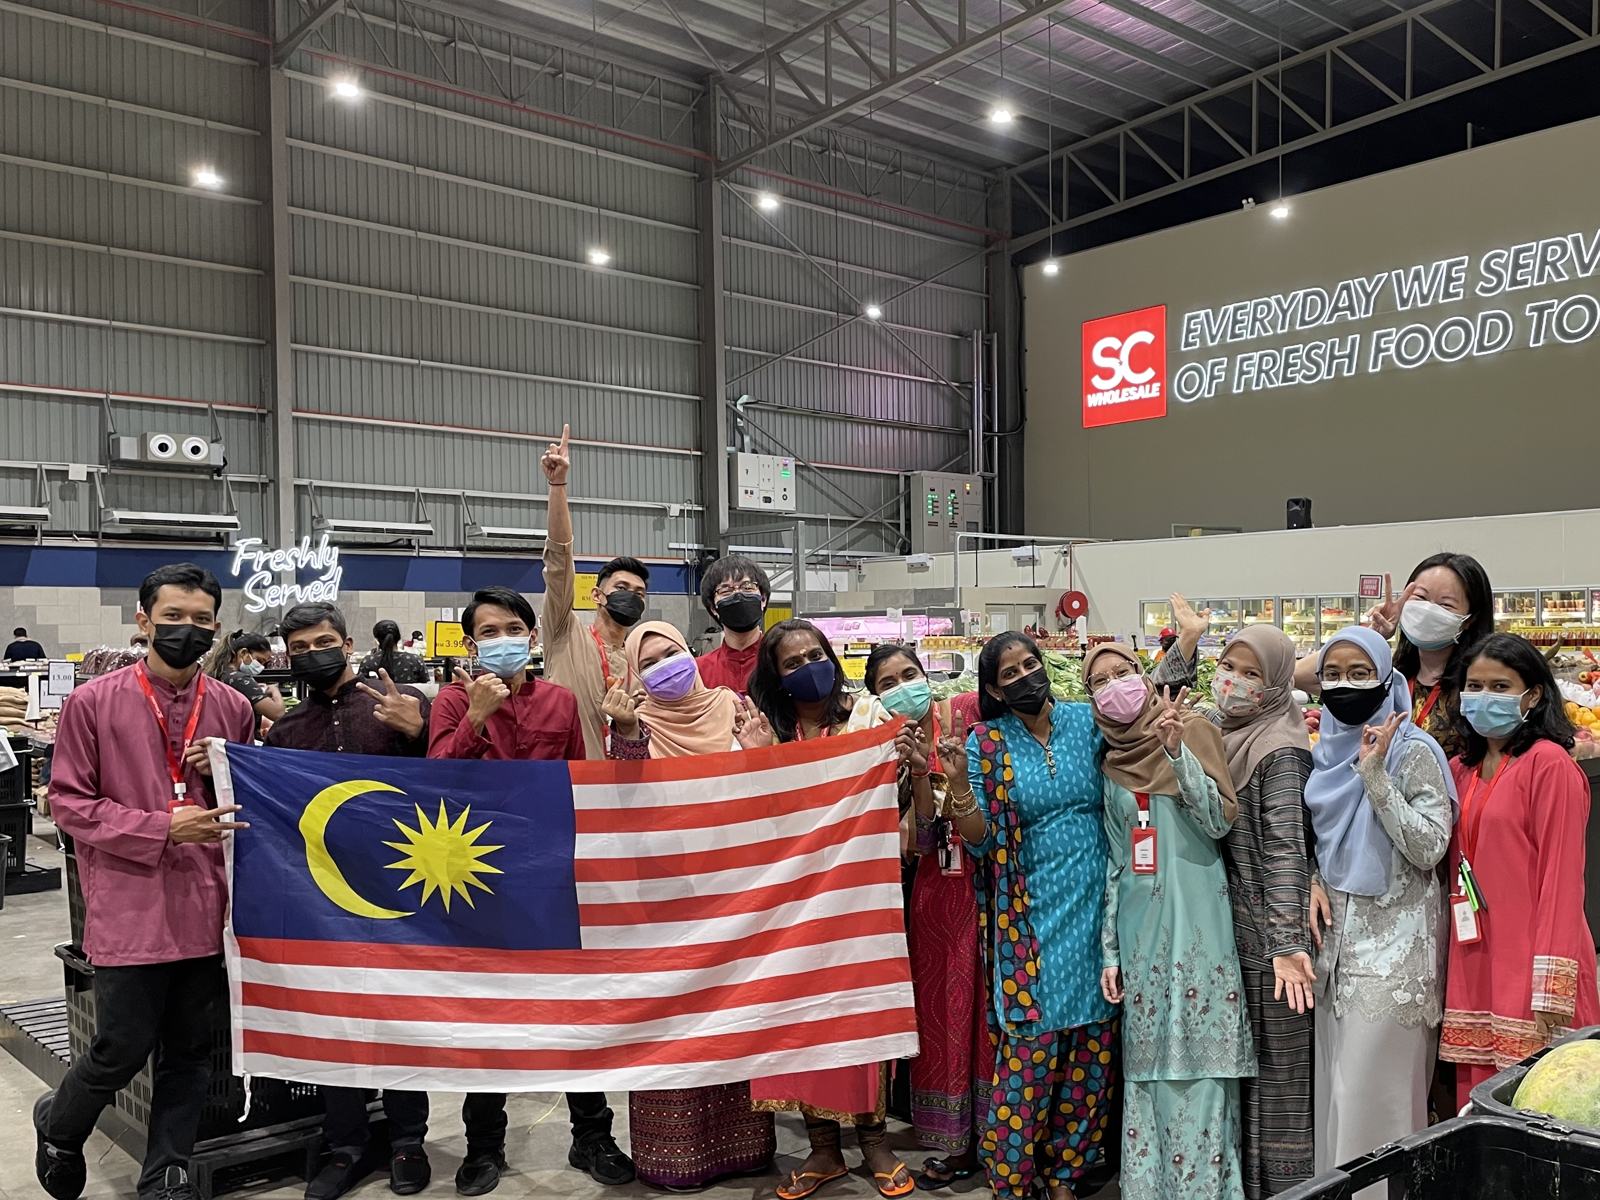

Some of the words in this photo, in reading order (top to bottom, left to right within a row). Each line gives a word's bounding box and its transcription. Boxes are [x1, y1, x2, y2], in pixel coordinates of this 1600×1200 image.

[1181, 272, 1389, 351] EVERYDAY
[1391, 255, 1469, 311] WE
[1091, 330, 1156, 391] SC
[1174, 357, 1228, 403] OF
[1232, 333, 1361, 394] FRESH
[1368, 309, 1514, 373] FOOD
[1525, 293, 1600, 348] TO
[1087, 382, 1161, 408] WHOLESALE
[231, 534, 339, 580] Freshly
[245, 566, 342, 612] Served
[445, 639, 464, 648] 3.99
